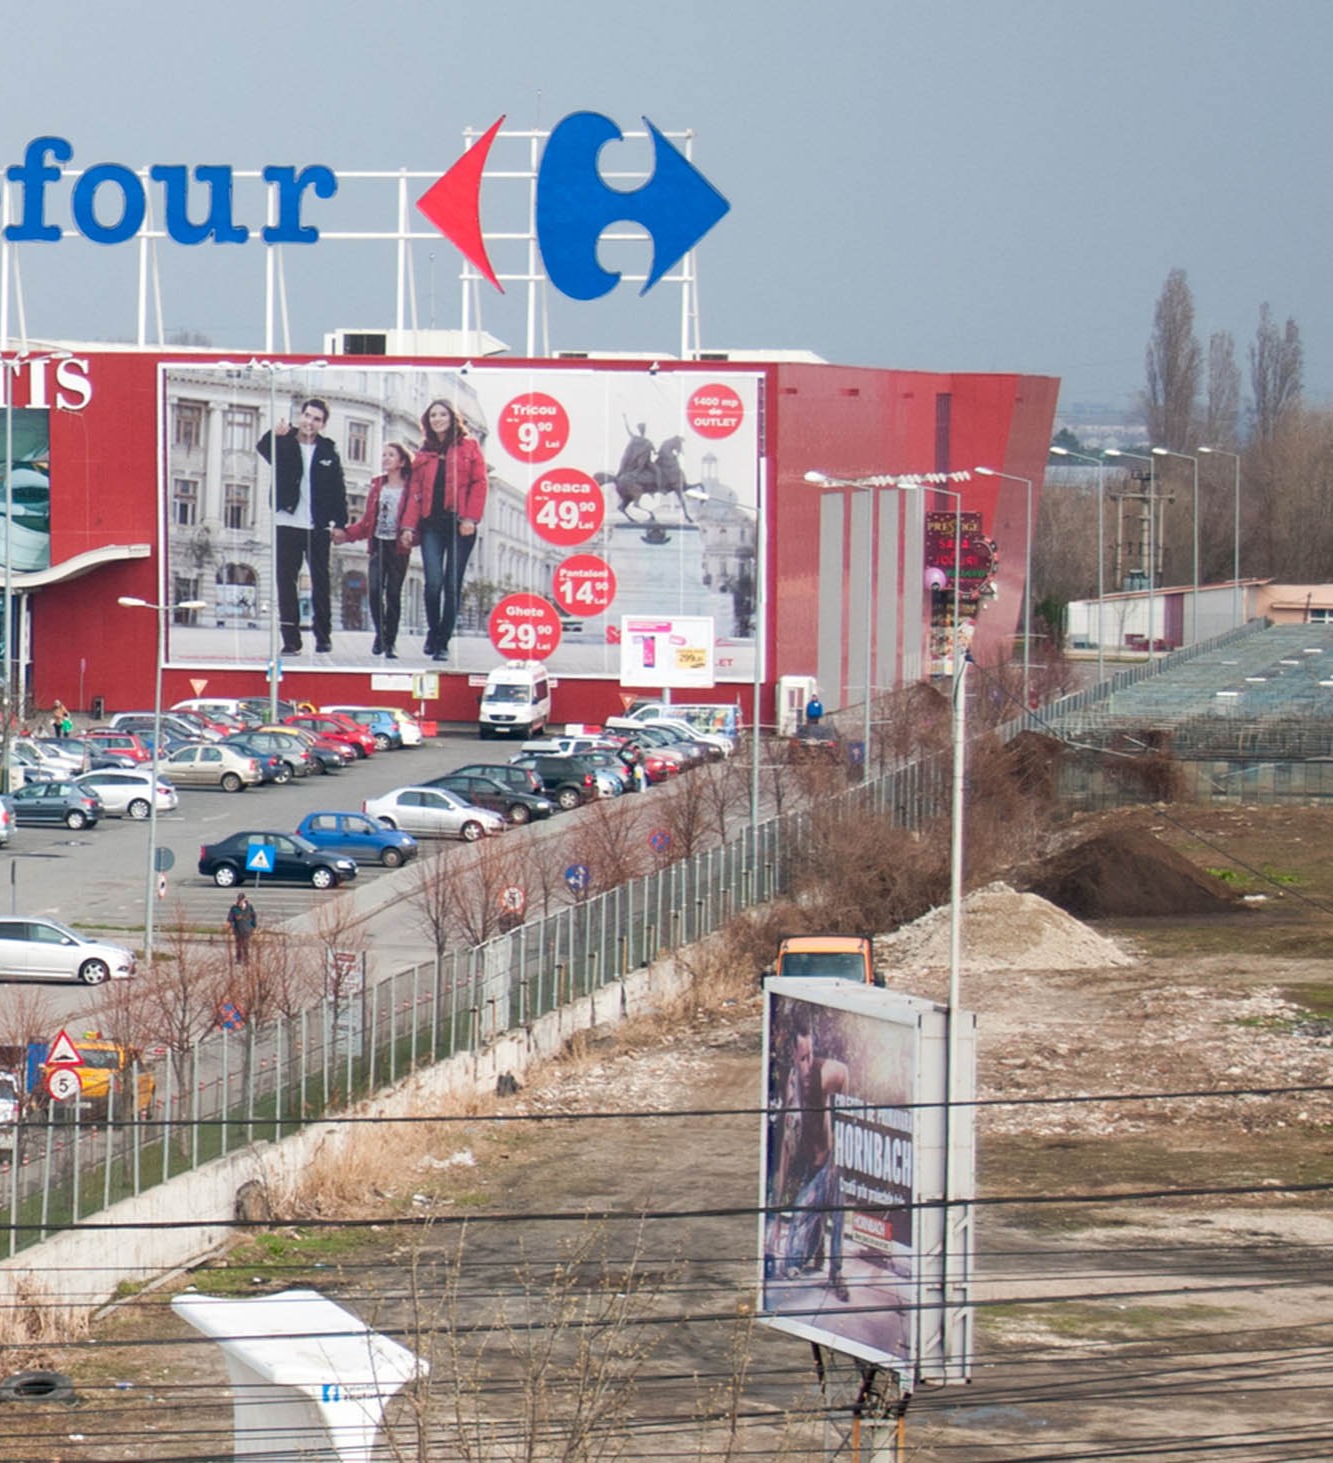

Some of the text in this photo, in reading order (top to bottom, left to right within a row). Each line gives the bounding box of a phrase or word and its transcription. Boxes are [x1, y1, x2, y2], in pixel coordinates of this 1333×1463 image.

[511, 404, 557, 416] Tricou
[694, 418, 737, 427] OUTLET
[518, 423, 540, 452] 9
[540, 480, 591, 493] Geaca
[536, 499, 580, 530] 49
[927, 520, 979, 534] PRESIGE
[938, 539, 970, 549] SAA
[559, 581, 594, 605] 14
[505, 605, 545, 617] Ghete
[496, 622, 537, 650] 29
[58, 1077, 69, 1094] 5
[834, 1119, 912, 1189] HORNBACH
